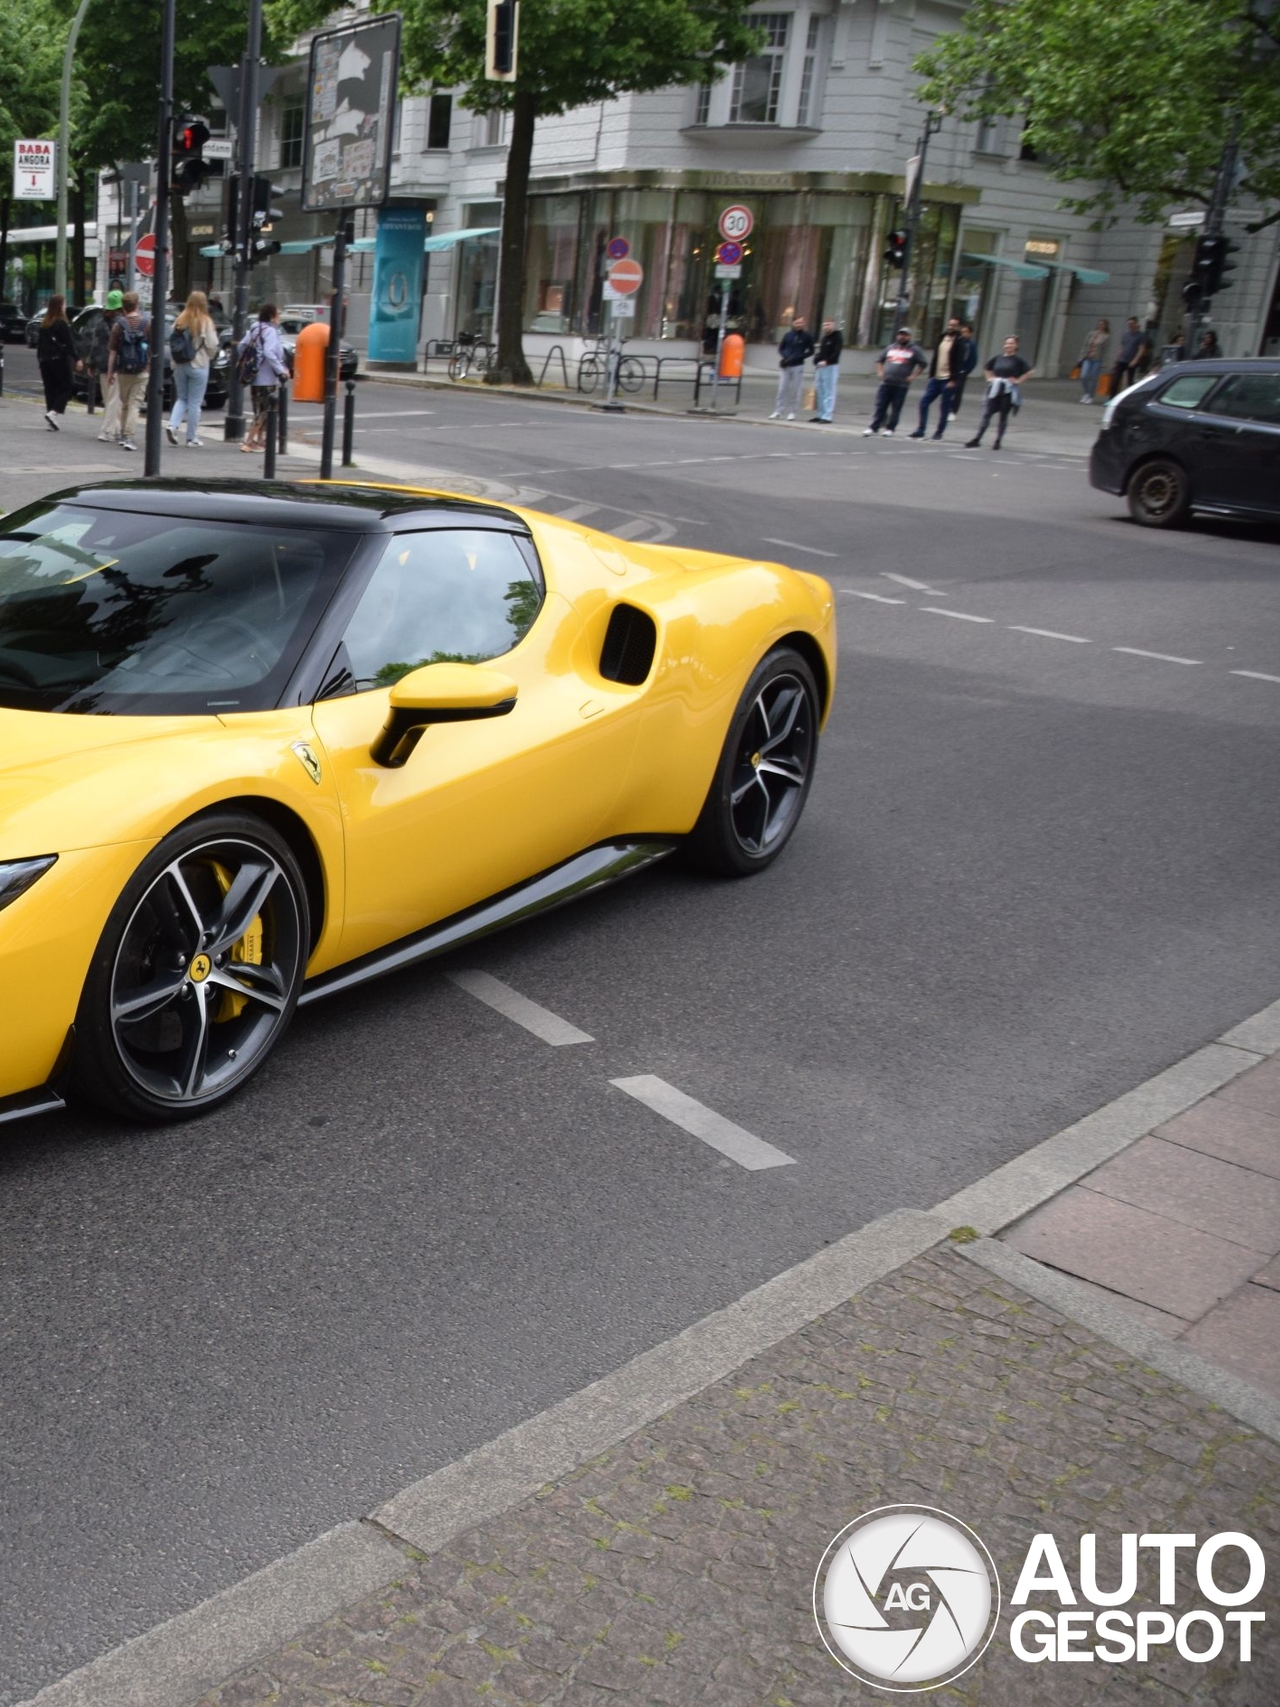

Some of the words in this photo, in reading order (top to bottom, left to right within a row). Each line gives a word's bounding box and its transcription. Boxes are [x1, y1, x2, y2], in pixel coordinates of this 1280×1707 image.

[18, 144, 51, 155] BABA
[18, 155, 51, 165] ANGORA
[727, 215, 746, 232] 30
